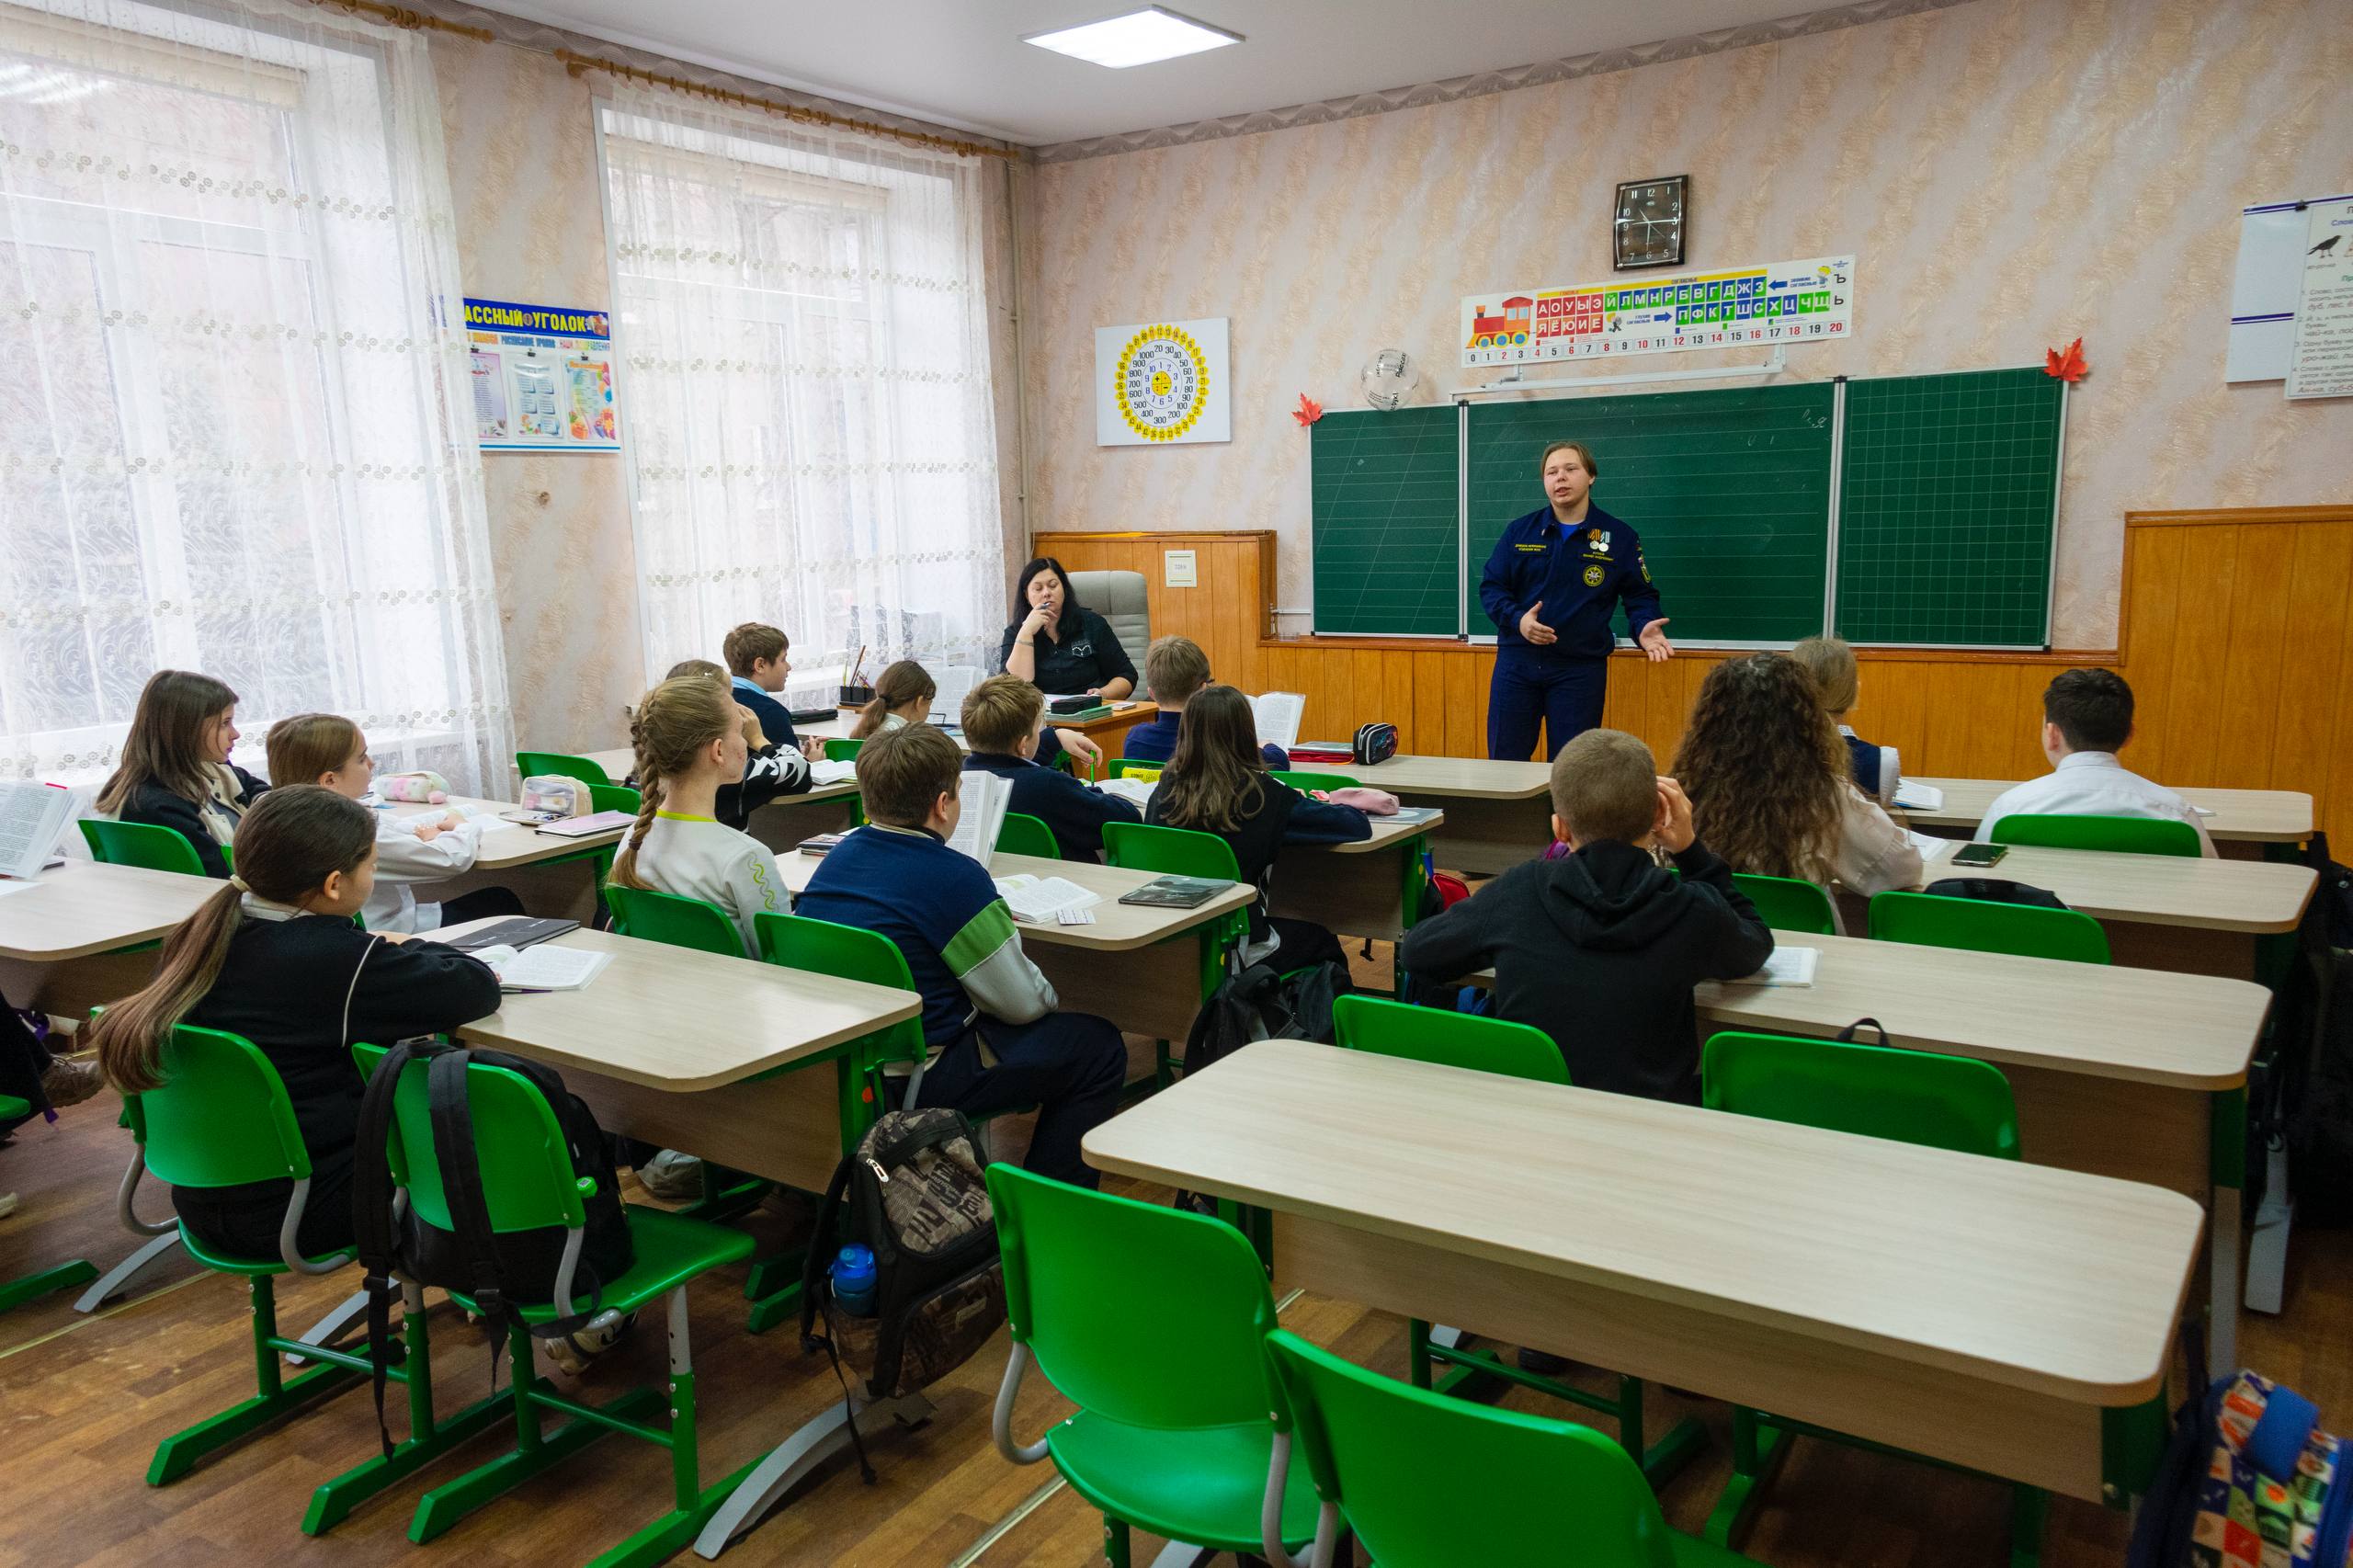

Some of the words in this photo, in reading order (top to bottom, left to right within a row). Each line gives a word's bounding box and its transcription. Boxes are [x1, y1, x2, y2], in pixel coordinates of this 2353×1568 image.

[1648, 188, 1654, 197] 12
[1672, 202, 1677, 210] 2
[1671, 232, 1676, 240] 4
[1664, 249, 1668, 257] 5
[1834, 274, 1846, 283] Ъ
[1539, 305, 1548, 313] А
[1552, 303, 1560, 312] О
[1566, 301, 1574, 311] У
[1577, 301, 1588, 310] Ы
[1594, 299, 1601, 308] Э
[1608, 294, 1616, 307] Й
[1621, 296, 1630, 306] Л
[1635, 295, 1645, 304] М
[1651, 293, 1659, 302] Н
[1665, 292, 1673, 301] Р
[1679, 290, 1688, 300] Б
[1694, 289, 1702, 298] В
[1710, 287, 1717, 297] Г
[1724, 286, 1733, 298] Д
[1738, 283, 1750, 293] Ж
[1756, 282, 1763, 291] З
[1835, 296, 1844, 305] Ь
[1678, 310, 1688, 320] П
[1692, 309, 1703, 318] Ф
[1709, 307, 1717, 316] К
[1724, 305, 1732, 315] Т
[1737, 305, 1750, 314] Ш
[1754, 303, 1763, 312] С
[1769, 301, 1779, 312] Х
[1785, 300, 1794, 312] Ц
[1802, 298, 1810, 307] Ч
[1814, 296, 1829, 308] Щ
[465, 305, 523, 326] АССНЫЙ
[532, 312, 586, 332] УГОЛОК
[1539, 324, 1547, 333] Я
[1552, 318, 1560, 332] Ё
[1563, 321, 1574, 330] Ю
[1578, 320, 1586, 329] И
[1593, 318, 1600, 327] Е
[1569, 347, 1574, 355] 6
[1587, 345, 1591, 353] 7
[1638, 340, 1647, 348] 10
[1656, 338, 1665, 347] 11
[1693, 335, 1703, 344] 13
[1711, 334, 1722, 342] 14
[1732, 332, 1741, 340] 15
[1750, 330, 1761, 338] 16
[1769, 328, 1780, 337] 17
[1789, 326, 1800, 335] 18
[1809, 324, 1821, 333] 19
[1830, 323, 1842, 332] 20
